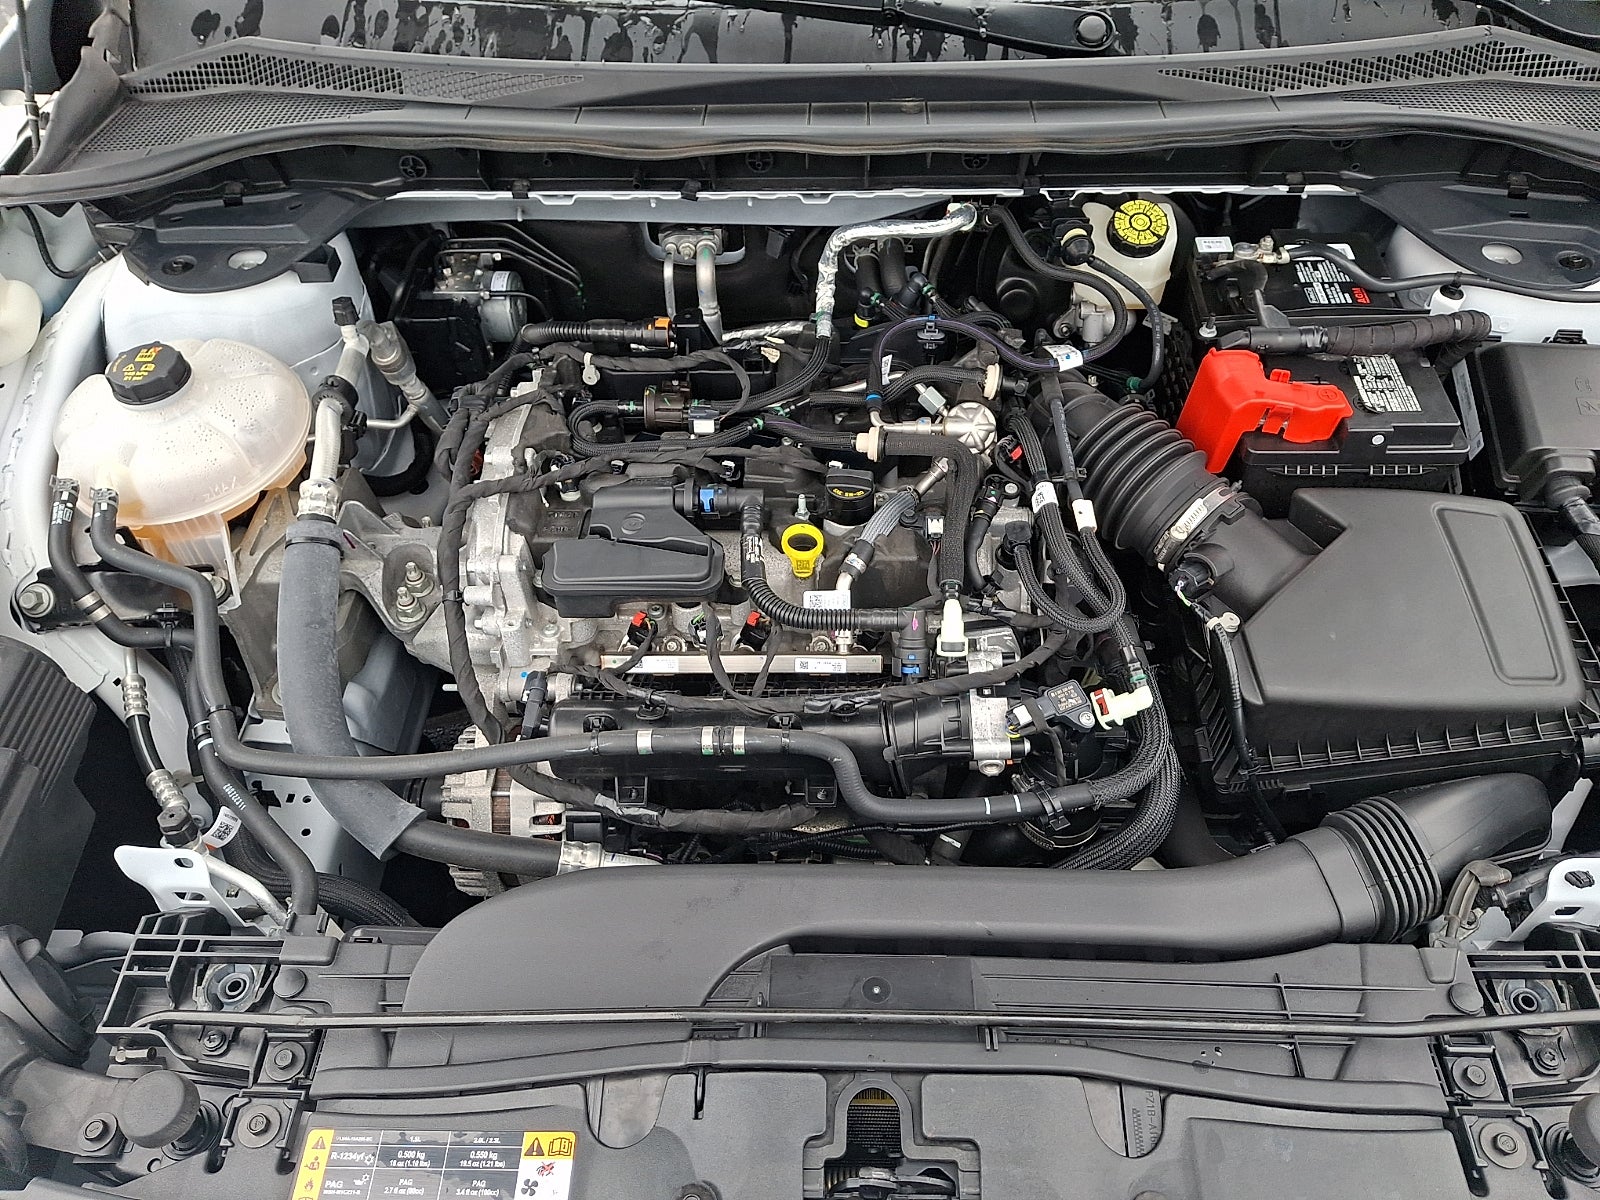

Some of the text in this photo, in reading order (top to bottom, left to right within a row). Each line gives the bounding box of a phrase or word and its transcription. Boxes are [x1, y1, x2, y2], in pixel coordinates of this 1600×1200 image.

[1352, 287, 1369, 303] AGM
[330, 1151, 365, 1162] R-1234yf
[397, 1150, 426, 1160] 0.500 kg
[469, 1150, 498, 1160] 0.550 kg
[325, 1180, 344, 1189] PAG
[471, 1180, 486, 1188] PAG
